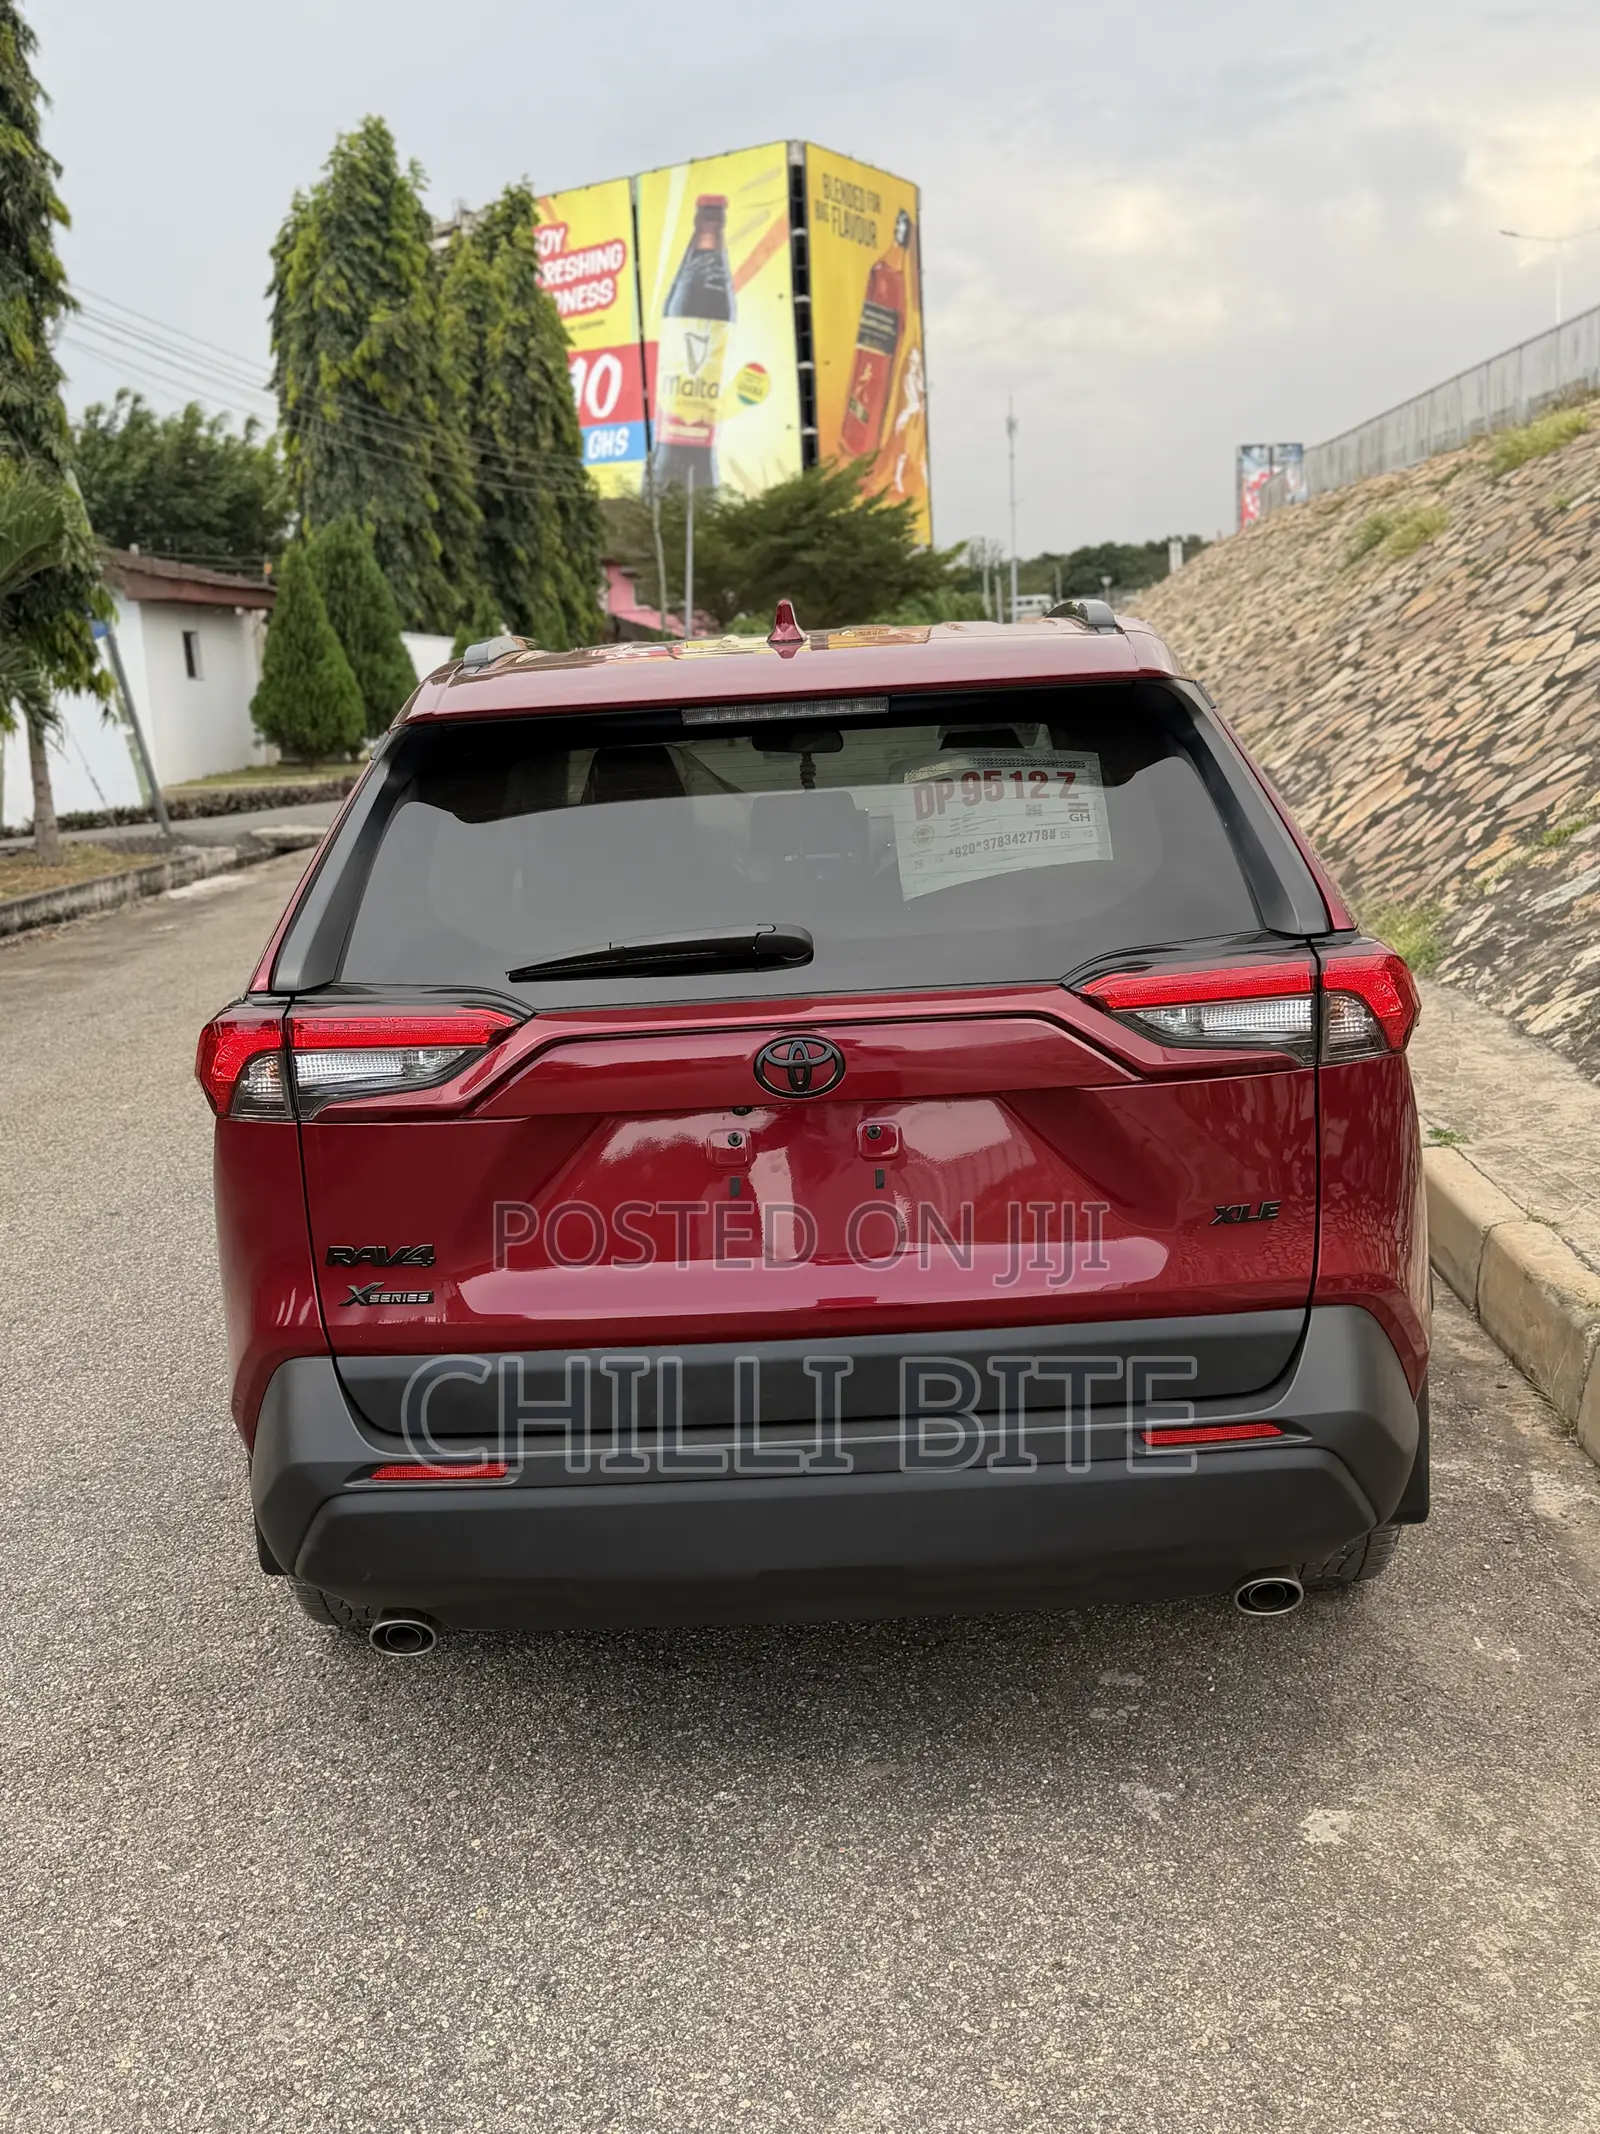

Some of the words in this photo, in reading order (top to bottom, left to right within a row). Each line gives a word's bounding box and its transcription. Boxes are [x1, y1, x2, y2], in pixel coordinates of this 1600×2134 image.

[822, 172, 865, 212] BLENDED
[534, 243, 623, 286] RESHING
[587, 426, 630, 459] GHS
[913, 779, 955, 820] DP
[960, 770, 1050, 806] 9512
[1069, 813, 1091, 822] GH
[1208, 1200, 1281, 1226] XLE
[326, 1243, 436, 1267] RAV4
